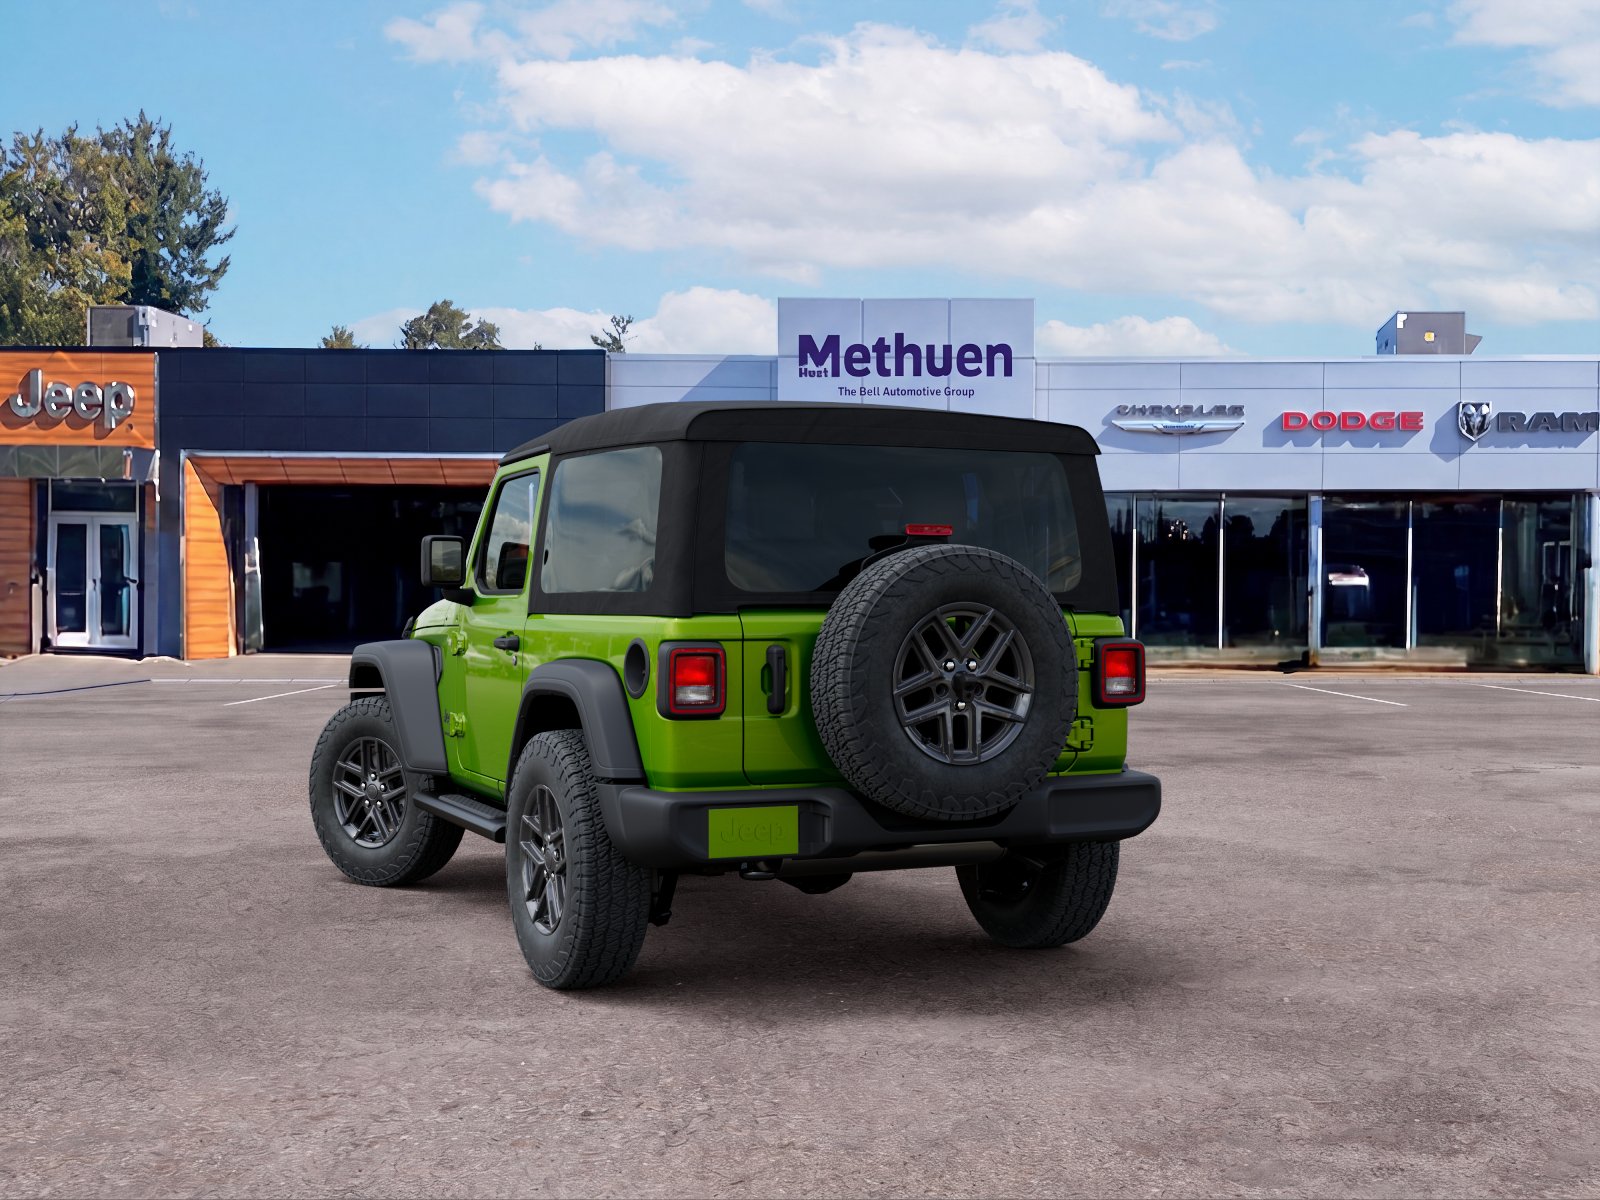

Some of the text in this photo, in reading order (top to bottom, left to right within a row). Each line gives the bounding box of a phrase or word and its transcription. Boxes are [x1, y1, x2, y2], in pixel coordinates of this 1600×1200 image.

[798, 332, 1013, 378] Methuen
[8, 368, 136, 429] Jeep
[838, 386, 975, 399] The Bell Automotive Group
[1282, 411, 1424, 431] DODGE
[1499, 411, 1600, 433] RAM
[720, 815, 784, 848] Jeep
